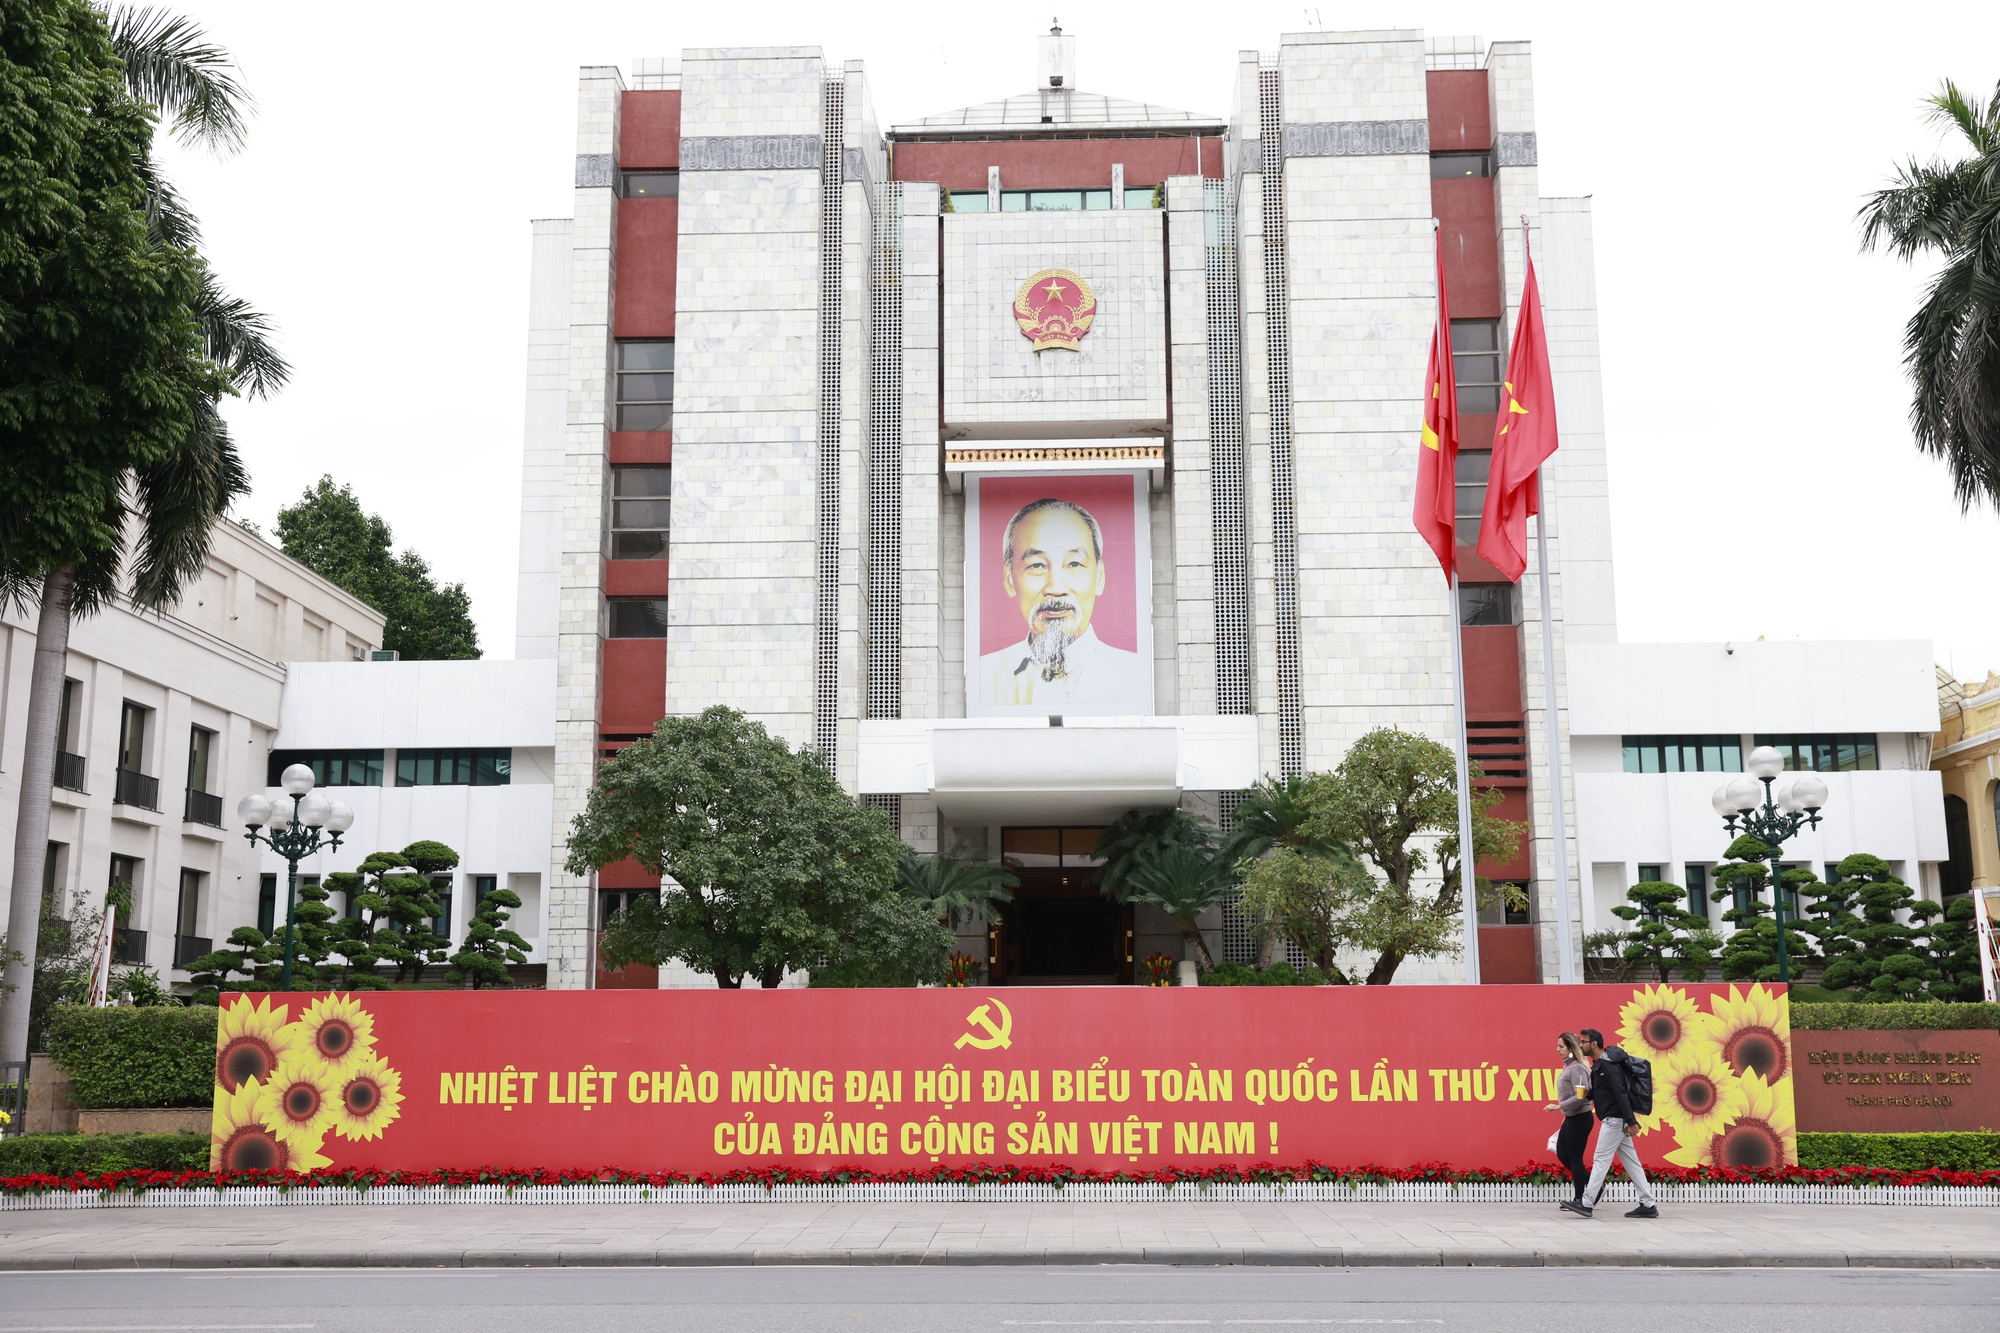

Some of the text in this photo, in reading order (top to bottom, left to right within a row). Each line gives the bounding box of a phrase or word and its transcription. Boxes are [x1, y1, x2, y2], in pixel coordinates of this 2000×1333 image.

[1808, 1050, 1840, 1067] HỘI
[1894, 1050, 1943, 1065] NHÂN
[1946, 1050, 1981, 1065] DÂN
[439, 1064, 539, 1111] NHIỆT
[548, 1064, 618, 1111] LIỆT
[628, 1063, 719, 1104] CHÀO
[731, 1063, 834, 1104] MỪNG
[844, 1070, 902, 1110] ĐẠI
[914, 1062, 971, 1110] HỘI
[981, 1069, 1040, 1110] ĐẠI
[1052, 1055, 1131, 1103] BIỂU
[1141, 1062, 1233, 1103] TOÀN
[1244, 1057, 1339, 1106] QUỐC
[1350, 1057, 1419, 1102] LẦN
[1428, 1063, 1500, 1102] THỨ
[1847, 1071, 1882, 1084] BAN
[1885, 1070, 1933, 1084] NHÂN
[1936, 1069, 1973, 1085] DÂN
[1846, 1093, 1953, 1109] THÀNH PHỐ HÀ NỘI
[713, 1110, 1280, 1163] CỦA ĐẢNG CỘNG SẢN VIỆT NAM !
